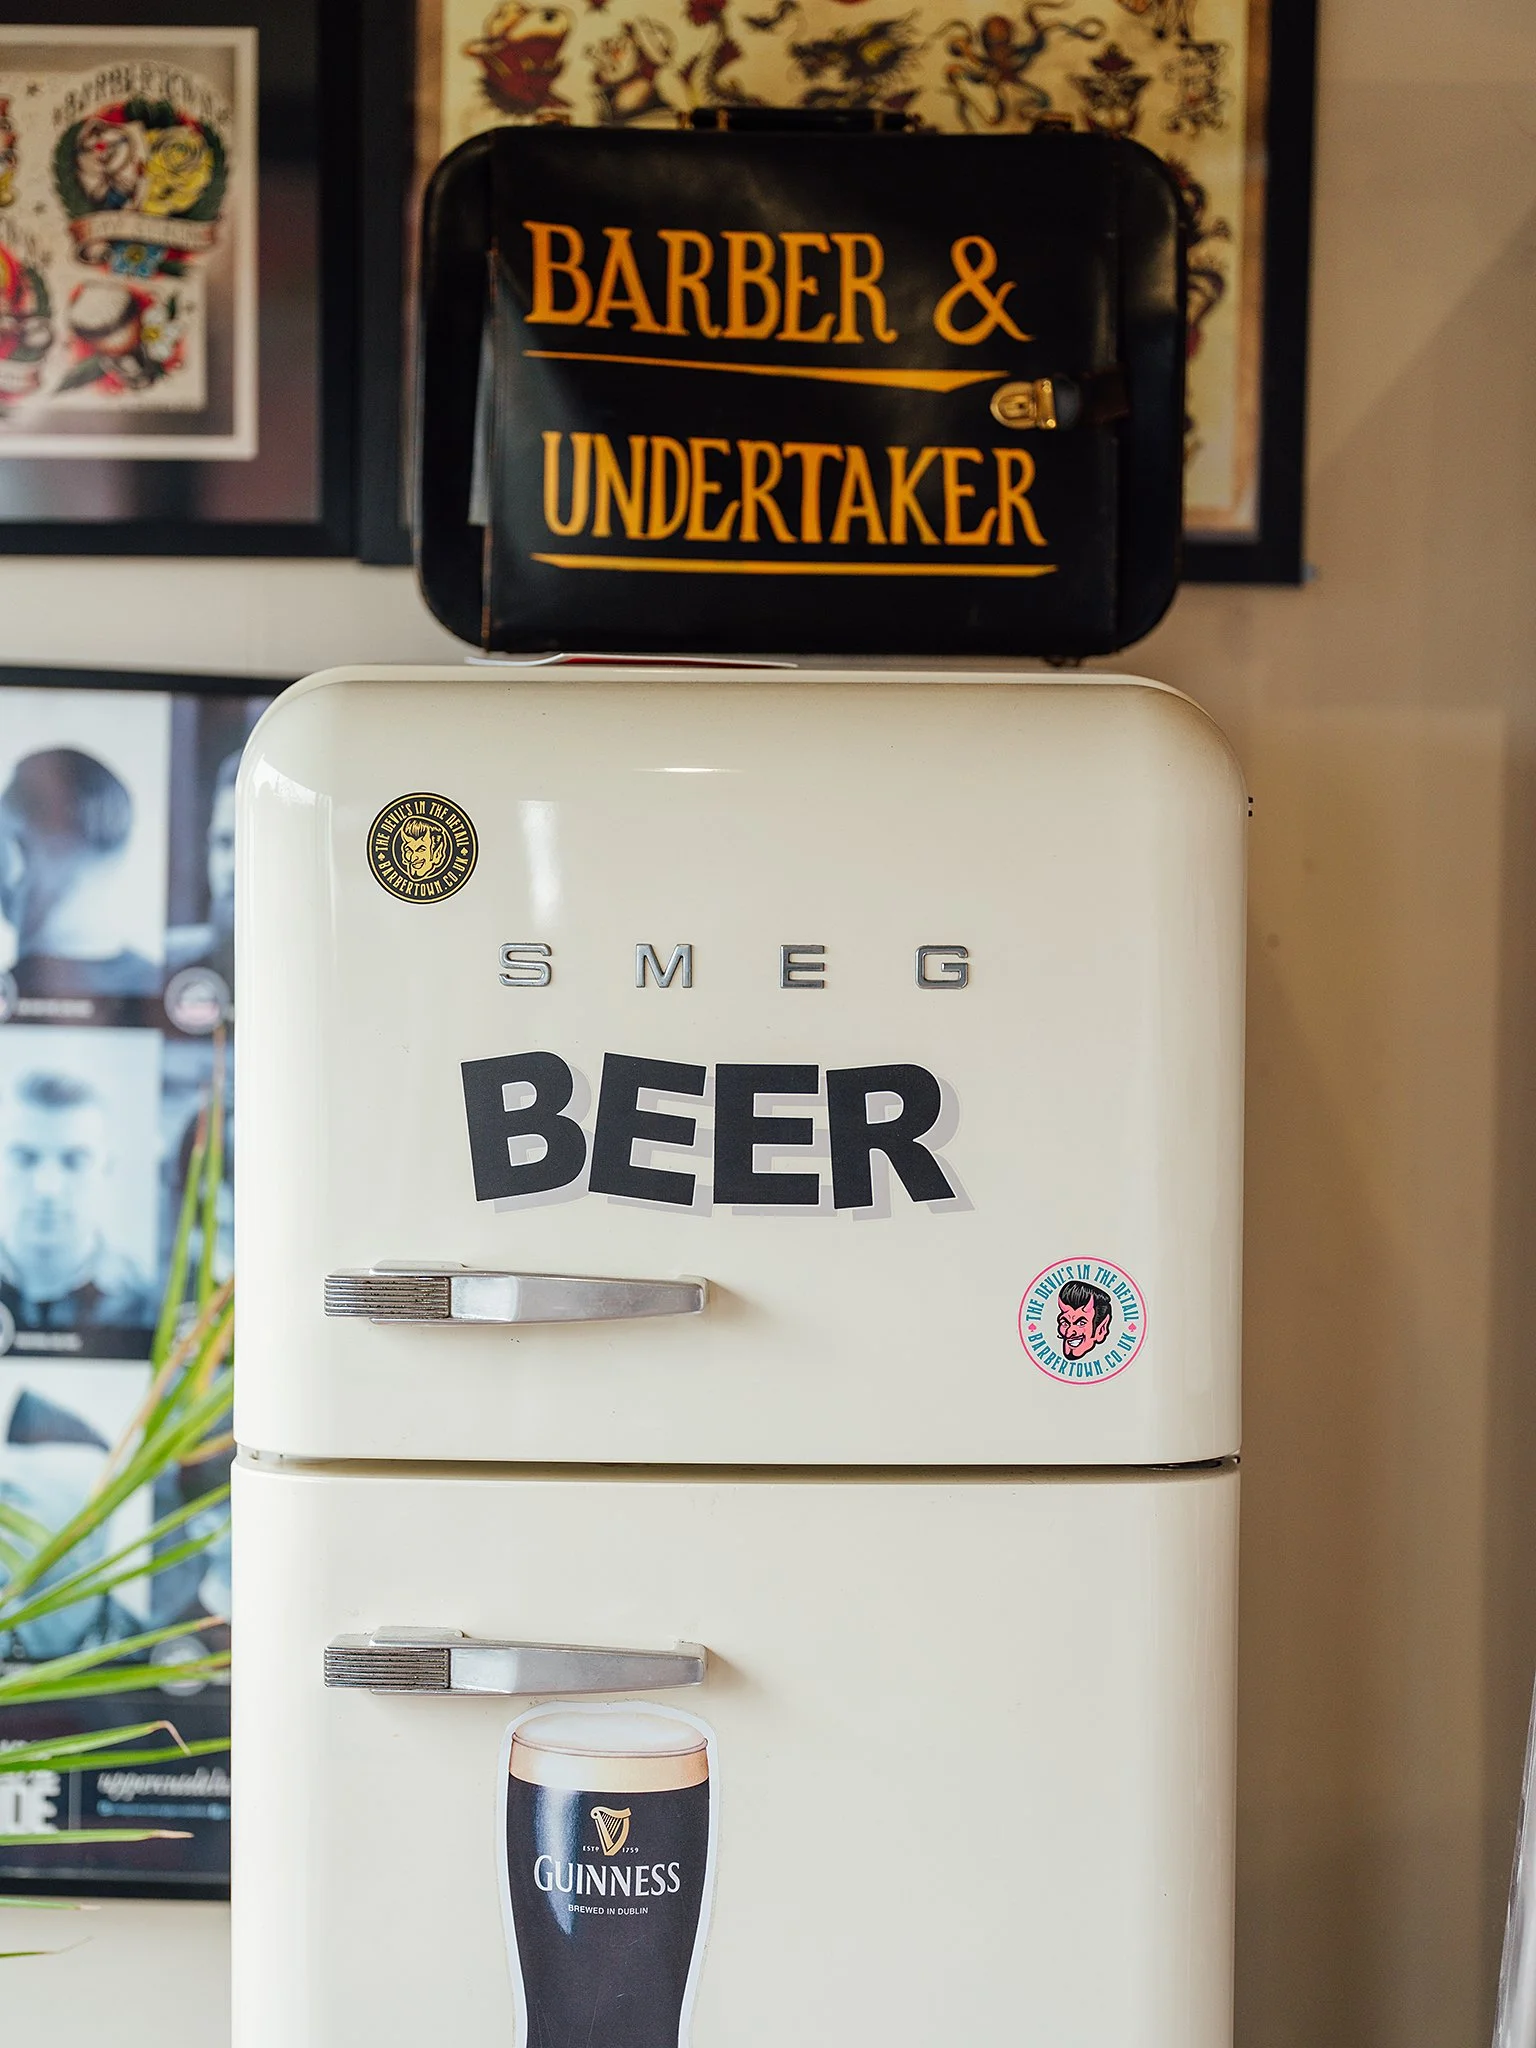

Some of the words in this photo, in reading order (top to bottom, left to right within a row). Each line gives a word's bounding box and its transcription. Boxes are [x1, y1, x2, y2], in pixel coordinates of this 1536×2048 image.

[522, 219, 898, 344] BARBER
[933, 235, 1034, 346] &
[541, 430, 1049, 547] UNDERTAKER
[381, 803, 413, 833] DEVIL'S
[414, 801, 426, 814] IN
[429, 802, 449, 820] THE
[375, 832, 390, 852] THE
[445, 812, 470, 847] DETAIL
[377, 856, 469, 897] BARBERTOWN.CO.UK
[498, 942, 971, 990] SMEG
[460, 1050, 962, 1213] BEER
[1034, 1265, 1075, 1301] DEVIL'S
[1077, 1264, 1091, 1280] IN
[1094, 1266, 1118, 1289] THE
[1026, 1299, 1045, 1322] THE
[1112, 1281, 1140, 1322] DETAIL
[1027, 1331, 1137, 1378] BARBERTOWN.CO.UK
[533, 1855, 681, 1897] GUINNESS
[568, 1904, 604, 1915] BREWED
[607, 1907, 615, 1915] IN
[618, 1907, 649, 1915] DUBLIN
